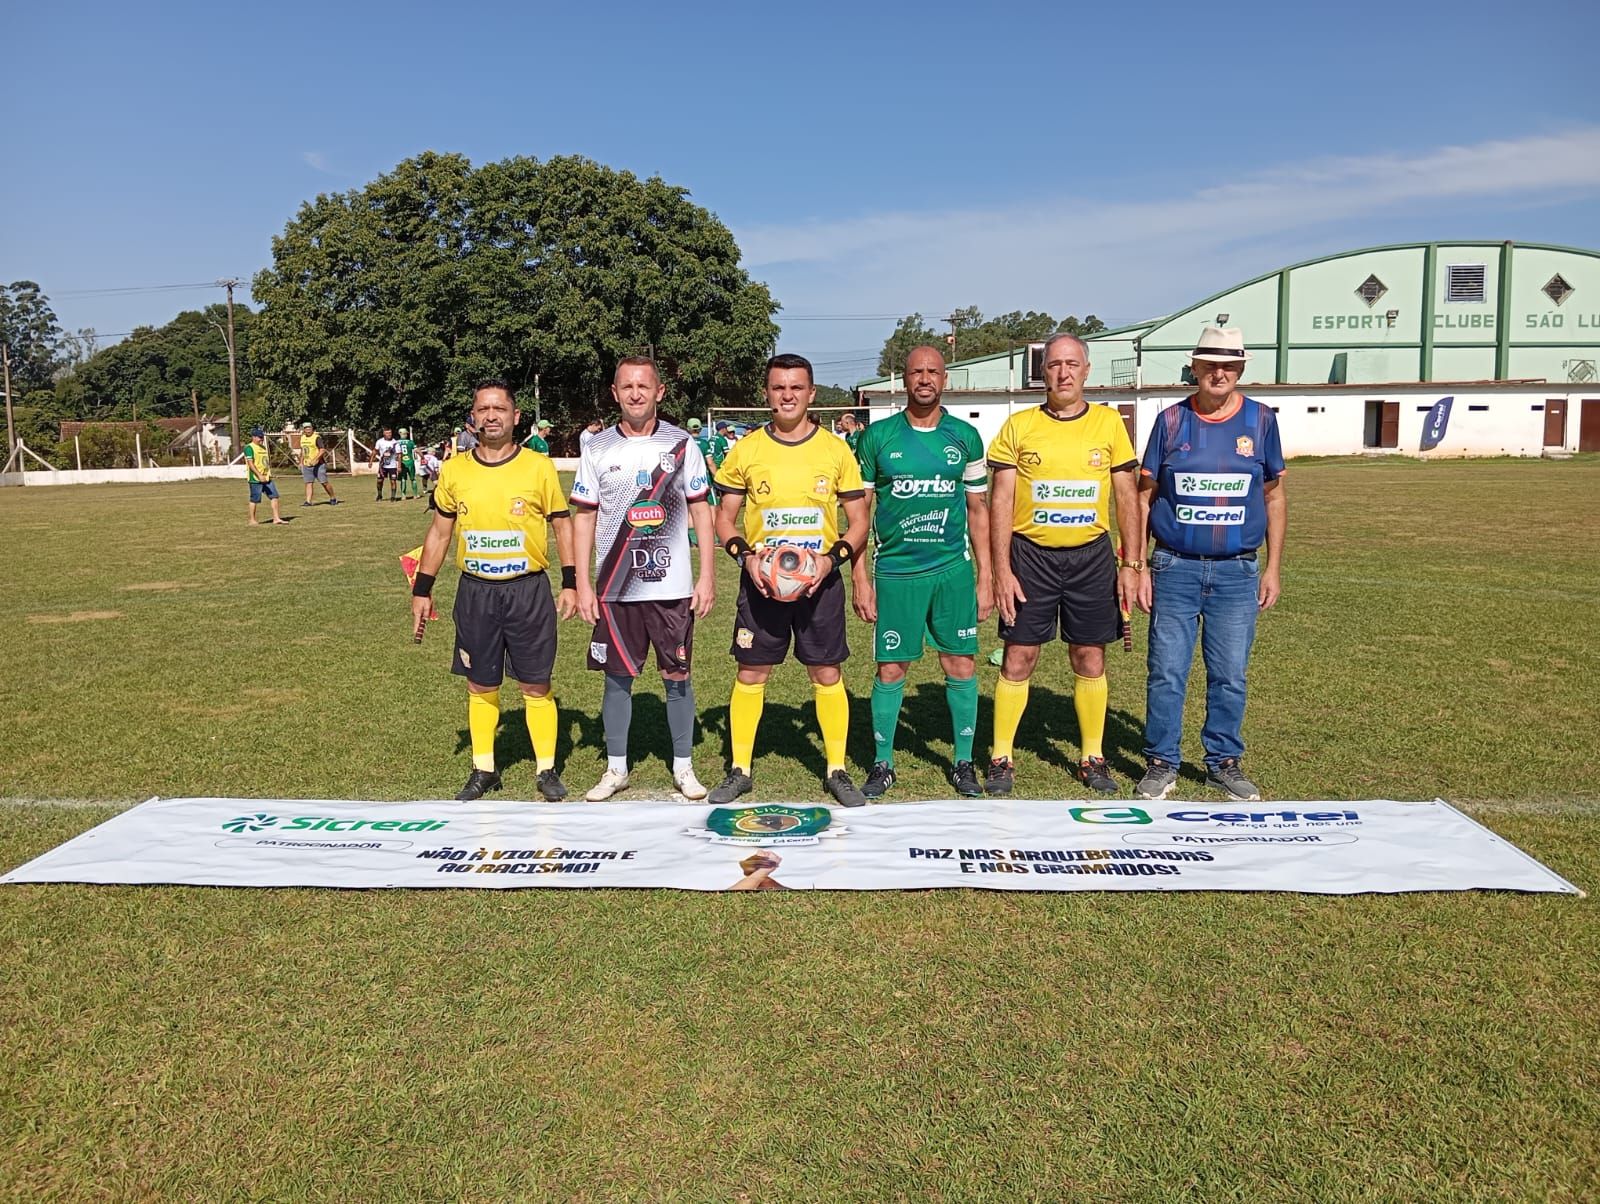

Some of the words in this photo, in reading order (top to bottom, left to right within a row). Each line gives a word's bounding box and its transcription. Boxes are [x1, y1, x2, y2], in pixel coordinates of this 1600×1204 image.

[1312, 314, 1396, 329] ESPORTE
[1433, 314, 1494, 328] CLUBE
[1526, 311, 1563, 328] SÃO
[1199, 479, 1245, 491] Sicredi
[1052, 486, 1096, 497] Sicredi
[631, 508, 662, 520] kroth
[901, 510, 944, 528] mercadão
[1049, 512, 1096, 524] Certel
[1194, 510, 1243, 521] Certel
[480, 561, 526, 574] Certel
[637, 569, 667, 578] GLASS
[1166, 810, 1360, 822] Certel
[281, 817, 450, 832] Sicredi
[256, 839, 382, 849] PATROCINADOR
[1172, 835, 1323, 844] PATROCINADOR
[416, 847, 467, 860] NÃO
[468, 848, 487, 861] À
[491, 848, 617, 860] VIOLÊNCIA
[621, 850, 638, 860] E
[909, 848, 955, 860] PAZ
[959, 848, 1005, 860] NAS
[1009, 849, 1215, 862] ARQUIBANCADAS
[436, 862, 474, 873] AO
[475, 862, 601, 874] RACISMO!
[961, 863, 976, 873] E
[981, 863, 1029, 874] NOS
[1034, 864, 1182, 876] GRAMADOS!
